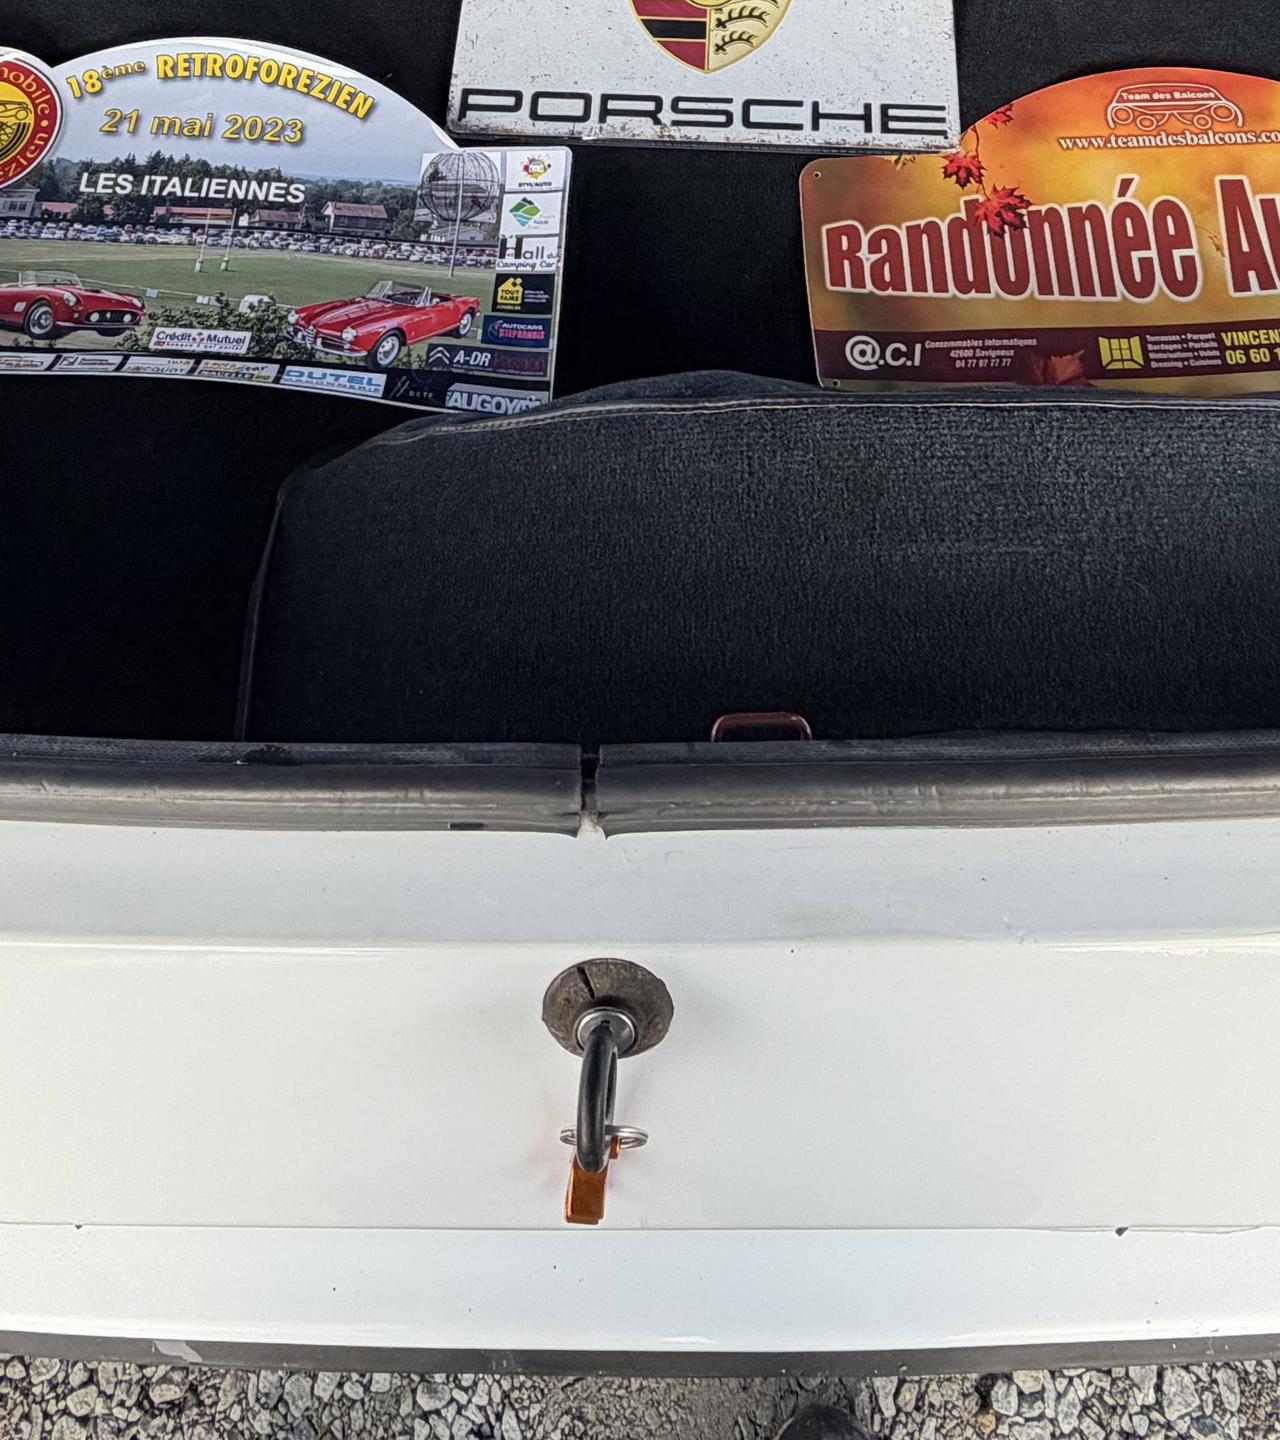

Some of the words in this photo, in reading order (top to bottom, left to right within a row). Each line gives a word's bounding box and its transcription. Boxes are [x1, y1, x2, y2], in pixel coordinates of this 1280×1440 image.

[66, 60, 147, 100] 18ème
[156, 52, 376, 120] RETROFOREZIEN
[1121, 92, 1150, 100] Team
[1152, 91, 1171, 100] des
[1174, 91, 1216, 99] Balcons
[458, 87, 949, 139] PORSCHE
[99, 107, 140, 134] 21
[150, 112, 214, 138] mai
[222, 113, 305, 144] 2023
[78, 171, 131, 195] LES
[141, 174, 306, 203] ITALIENNES
[822, 177, 1201, 300] Randonnée
[497, 261, 537, 271] Camping
[502, 322, 544, 330] AUTOCARS
[156, 331, 192, 341] Crédit
[206, 334, 247, 345] Mutuel
[453, 350, 491, 367] A-DR
[1225, 348, 1246, 365] 06
[1251, 347, 1270, 363] 60
